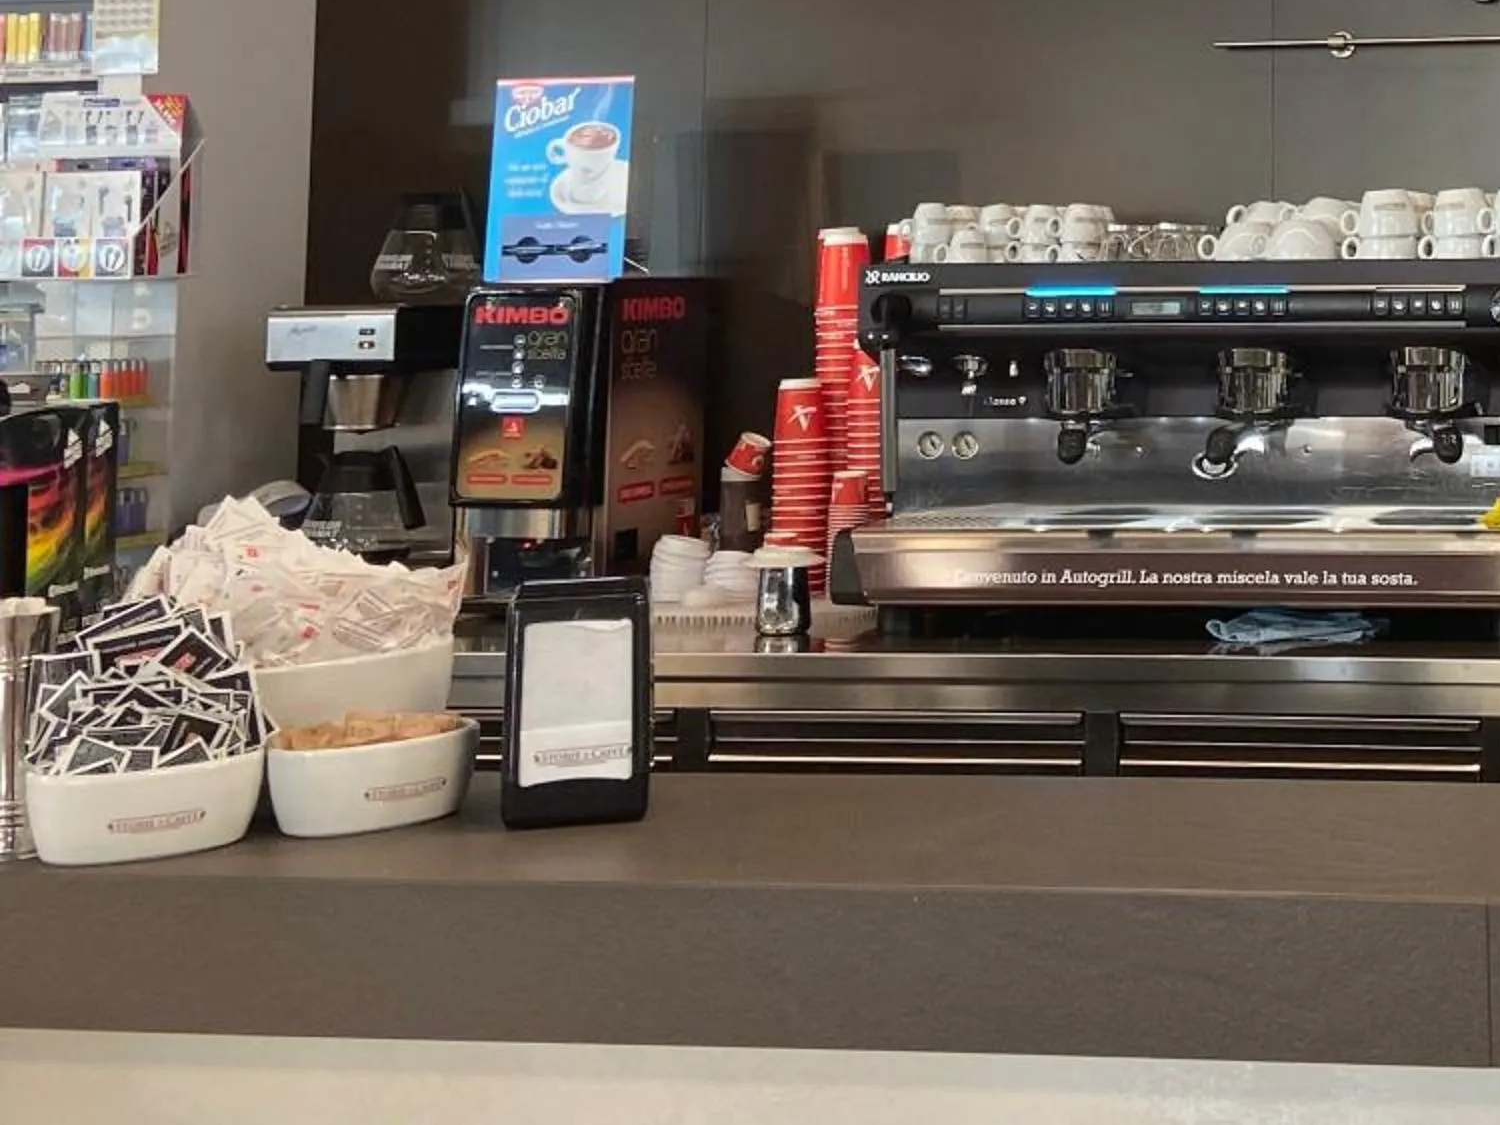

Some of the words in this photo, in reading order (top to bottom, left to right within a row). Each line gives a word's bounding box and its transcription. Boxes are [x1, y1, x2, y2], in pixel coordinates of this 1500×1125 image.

[504, 87, 582, 133] Ciobar
[475, 304, 569, 326] KIMBO
[622, 296, 686, 322] KIMBO
[1041, 569, 1057, 585] in
[1059, 569, 1137, 588] Autogrill.
[1139, 570, 1159, 585] La
[1161, 571, 1213, 585] nostra
[1215, 569, 1281, 585] miscela
[1283, 571, 1319, 586] vale
[1322, 571, 1338, 585] la
[1341, 572, 1367, 586] tua
[1370, 572, 1419, 586] sosta.
